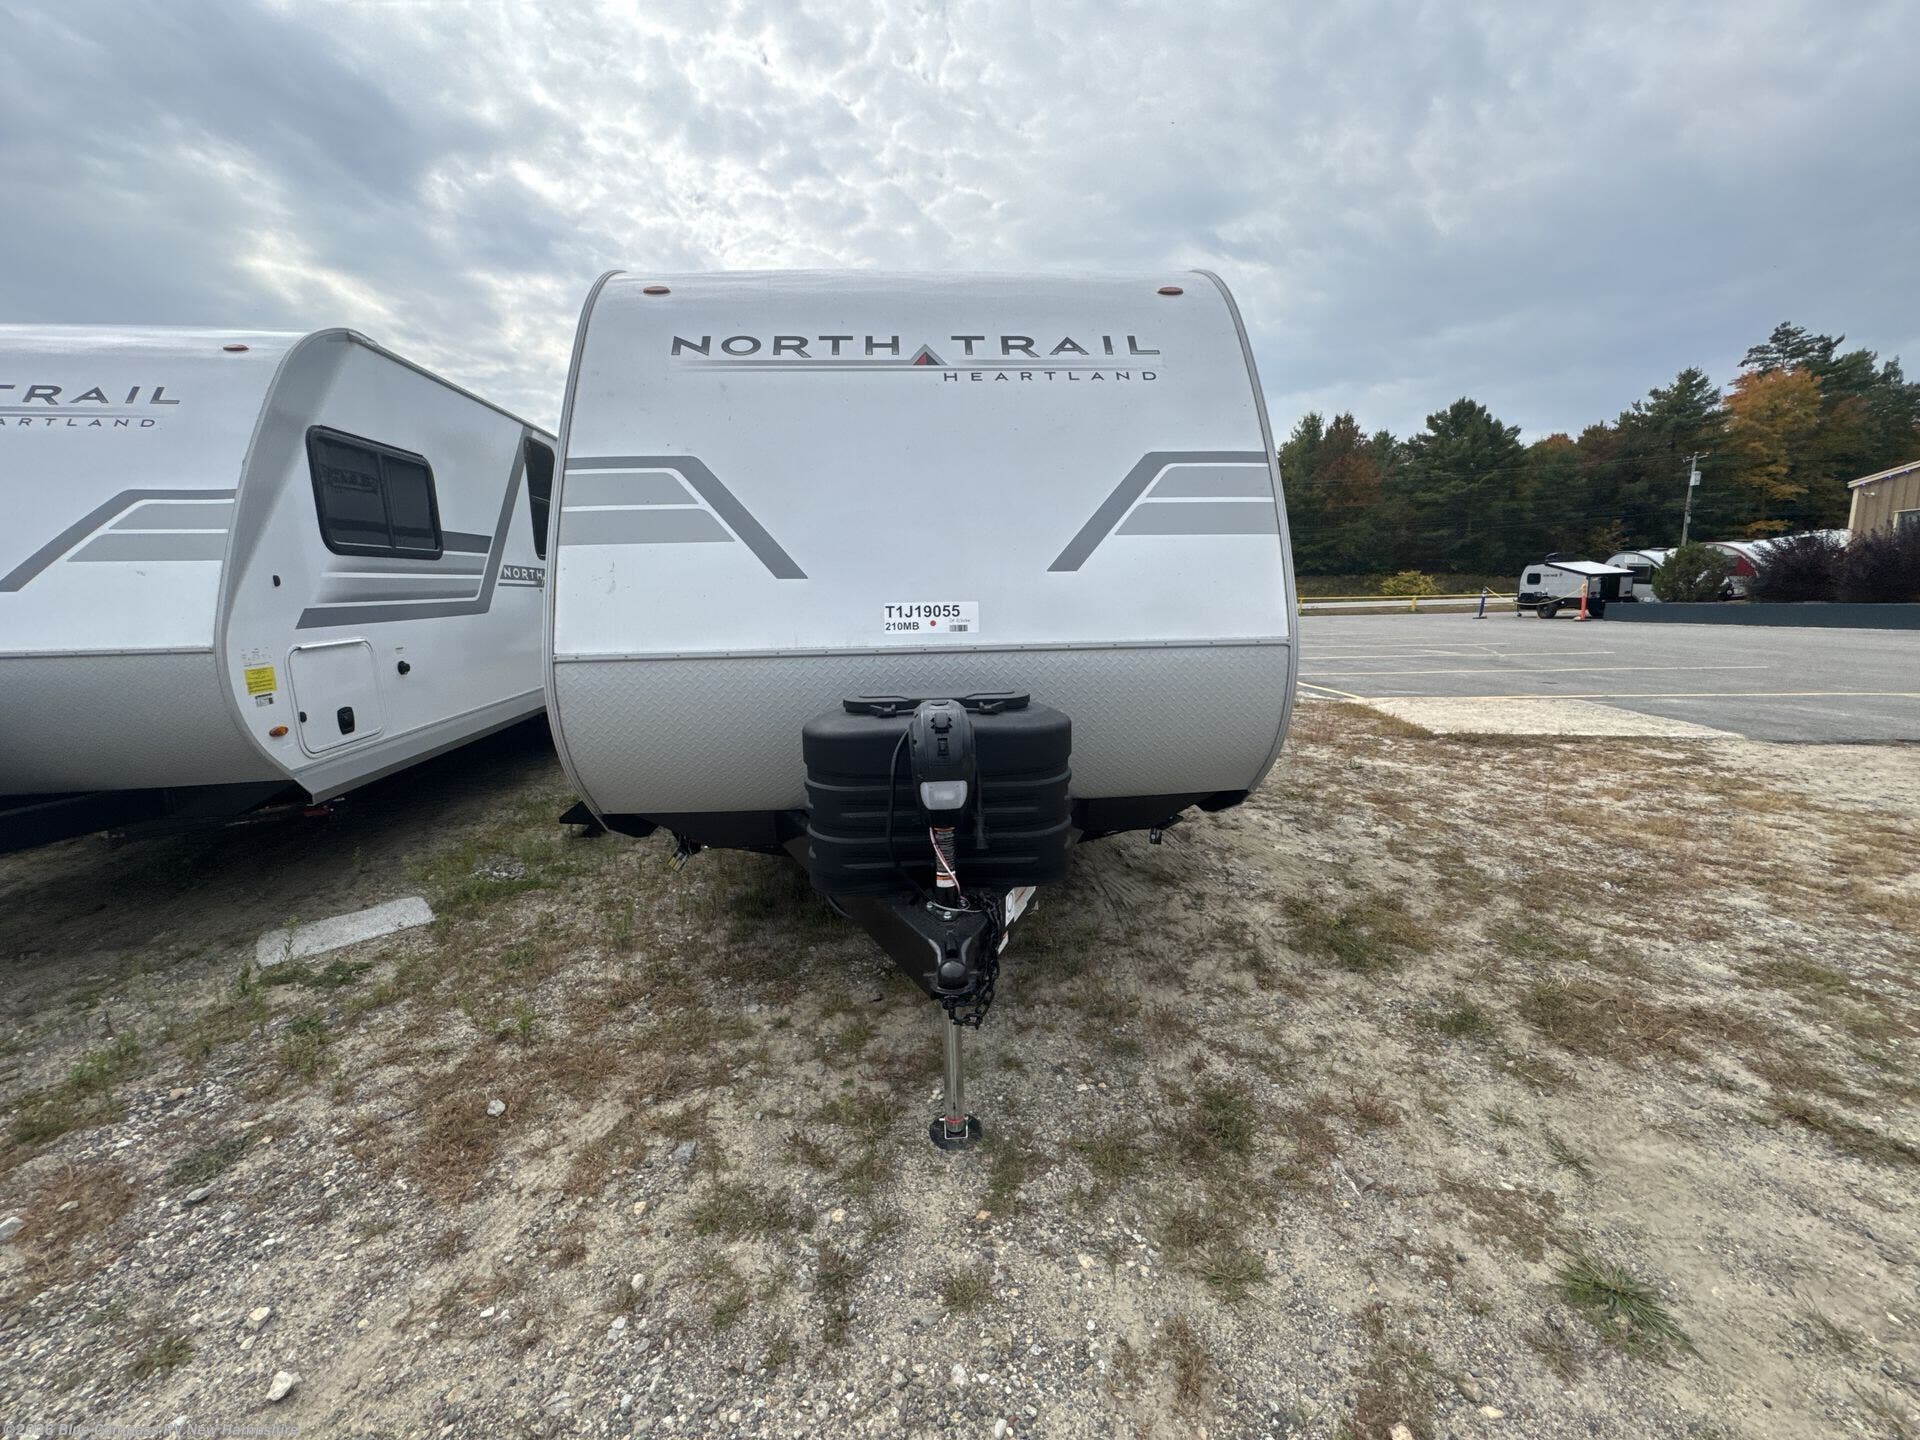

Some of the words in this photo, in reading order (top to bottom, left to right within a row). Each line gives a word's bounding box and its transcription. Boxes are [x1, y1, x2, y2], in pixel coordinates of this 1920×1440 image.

[671, 335, 900, 358] NORTH
[950, 335, 1161, 358] TRAIL
[943, 371, 1158, 382] HEARTLAND
[503, 567, 543, 580] NORTH
[885, 604, 961, 618] T1J19055
[885, 621, 920, 631] 210MB
